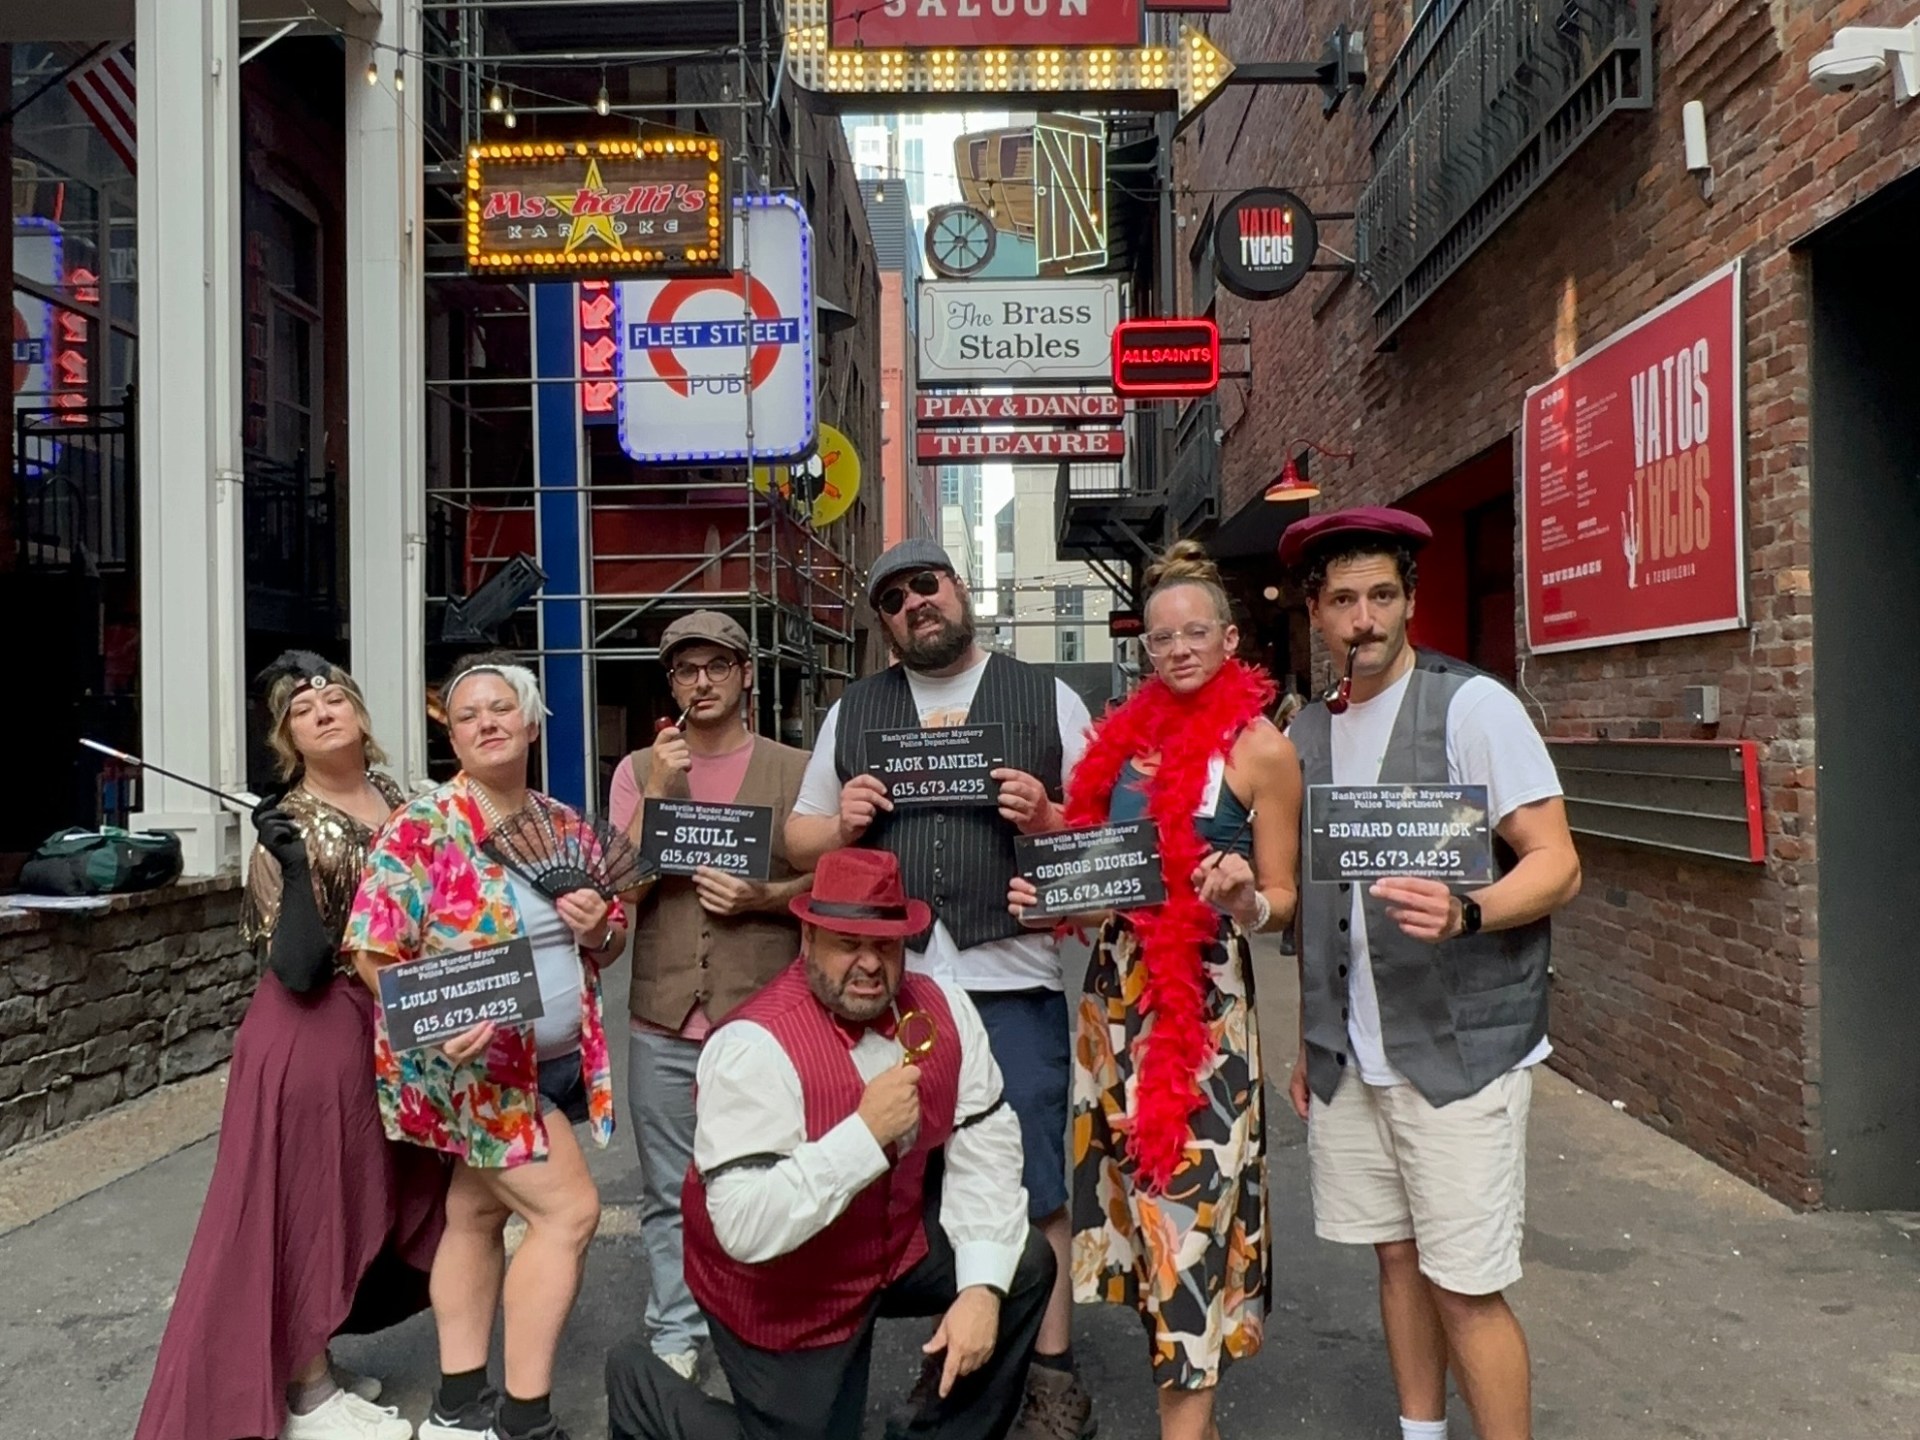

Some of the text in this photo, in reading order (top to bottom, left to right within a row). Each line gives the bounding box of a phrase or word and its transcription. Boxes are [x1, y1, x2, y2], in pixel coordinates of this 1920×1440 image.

[484, 184, 706, 219] Ms. Kelli's
[508, 219, 679, 239] KARAOKE
[946, 301, 1091, 329] The Brass
[634, 326, 702, 346] FLEET
[959, 333, 1080, 360] Stables
[1121, 348, 1212, 363] ALLSAINTS
[690, 373, 743, 396] PUB
[924, 395, 1118, 417] PLAY & DANCE
[1630, 338, 1710, 469] VATOS
[933, 433, 1110, 455] THEATRE
[1541, 559, 1602, 586] BEVERAGES
[1653, 562, 1696, 584] TEQUILERIA
[881, 729, 984, 743] Nashville Murder Mystery
[900, 737, 970, 748] Police Department
[884, 756, 924, 773] JACK
[928, 753, 988, 770] DANIEL
[892, 778, 985, 797] 615.673.4235
[1332, 790, 1462, 801] Nashville Murder Mystery
[659, 803, 755, 818] Nashville Murder Mystery
[1354, 799, 1444, 810] Police Department
[675, 812, 740, 823] Police Department
[674, 826, 738, 847] SKULL
[1034, 825, 1139, 847] Nashville Murder Mystery
[1328, 823, 1393, 838] EDWARD
[1396, 822, 1471, 837] CARMACK
[1053, 835, 1125, 852] Police Department
[660, 849, 748, 868] 615.673.4235
[1036, 859, 1091, 879] GEORGE
[1094, 851, 1147, 872] DICKEL
[1339, 850, 1461, 867] 615.673.4235
[1045, 877, 1141, 905] 615.673.4235
[400, 989, 438, 1011] LULU
[440, 971, 521, 1000] VALENTINE
[413, 997, 518, 1036] 615.673.4235
